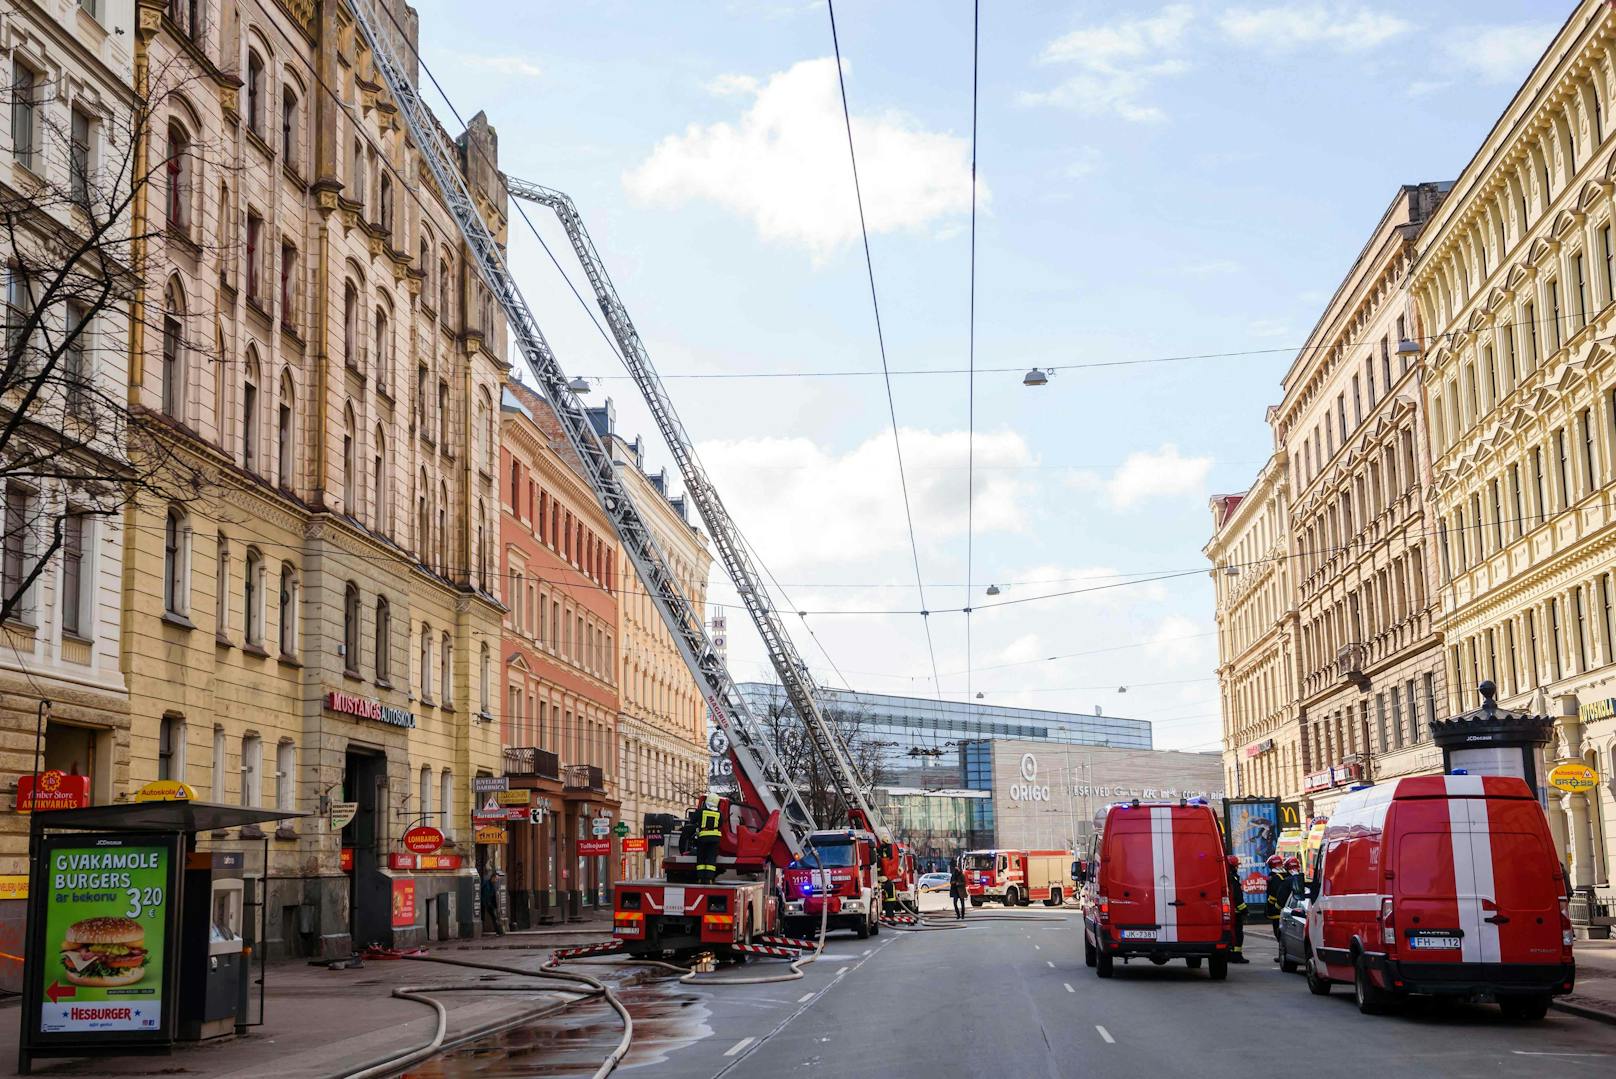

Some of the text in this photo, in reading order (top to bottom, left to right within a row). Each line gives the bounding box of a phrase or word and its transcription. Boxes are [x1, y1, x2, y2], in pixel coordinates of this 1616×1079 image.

[333, 692, 416, 728] MUSTANGS AUTOSKOLA
[708, 695, 729, 730] MAGIRUS
[1580, 698, 1614, 723] AUTOSKOLA
[54, 791, 73, 799] Store
[142, 788, 176, 796] Autoskola
[1009, 783, 1050, 802] ORIGO
[408, 835, 440, 843] LOMBARDS
[56, 853, 159, 870] GVAKAMOLE
[55, 873, 132, 889] BURGERS
[55, 891, 117, 903] ar bekonu
[71, 1007, 132, 1021] HESBURGER
